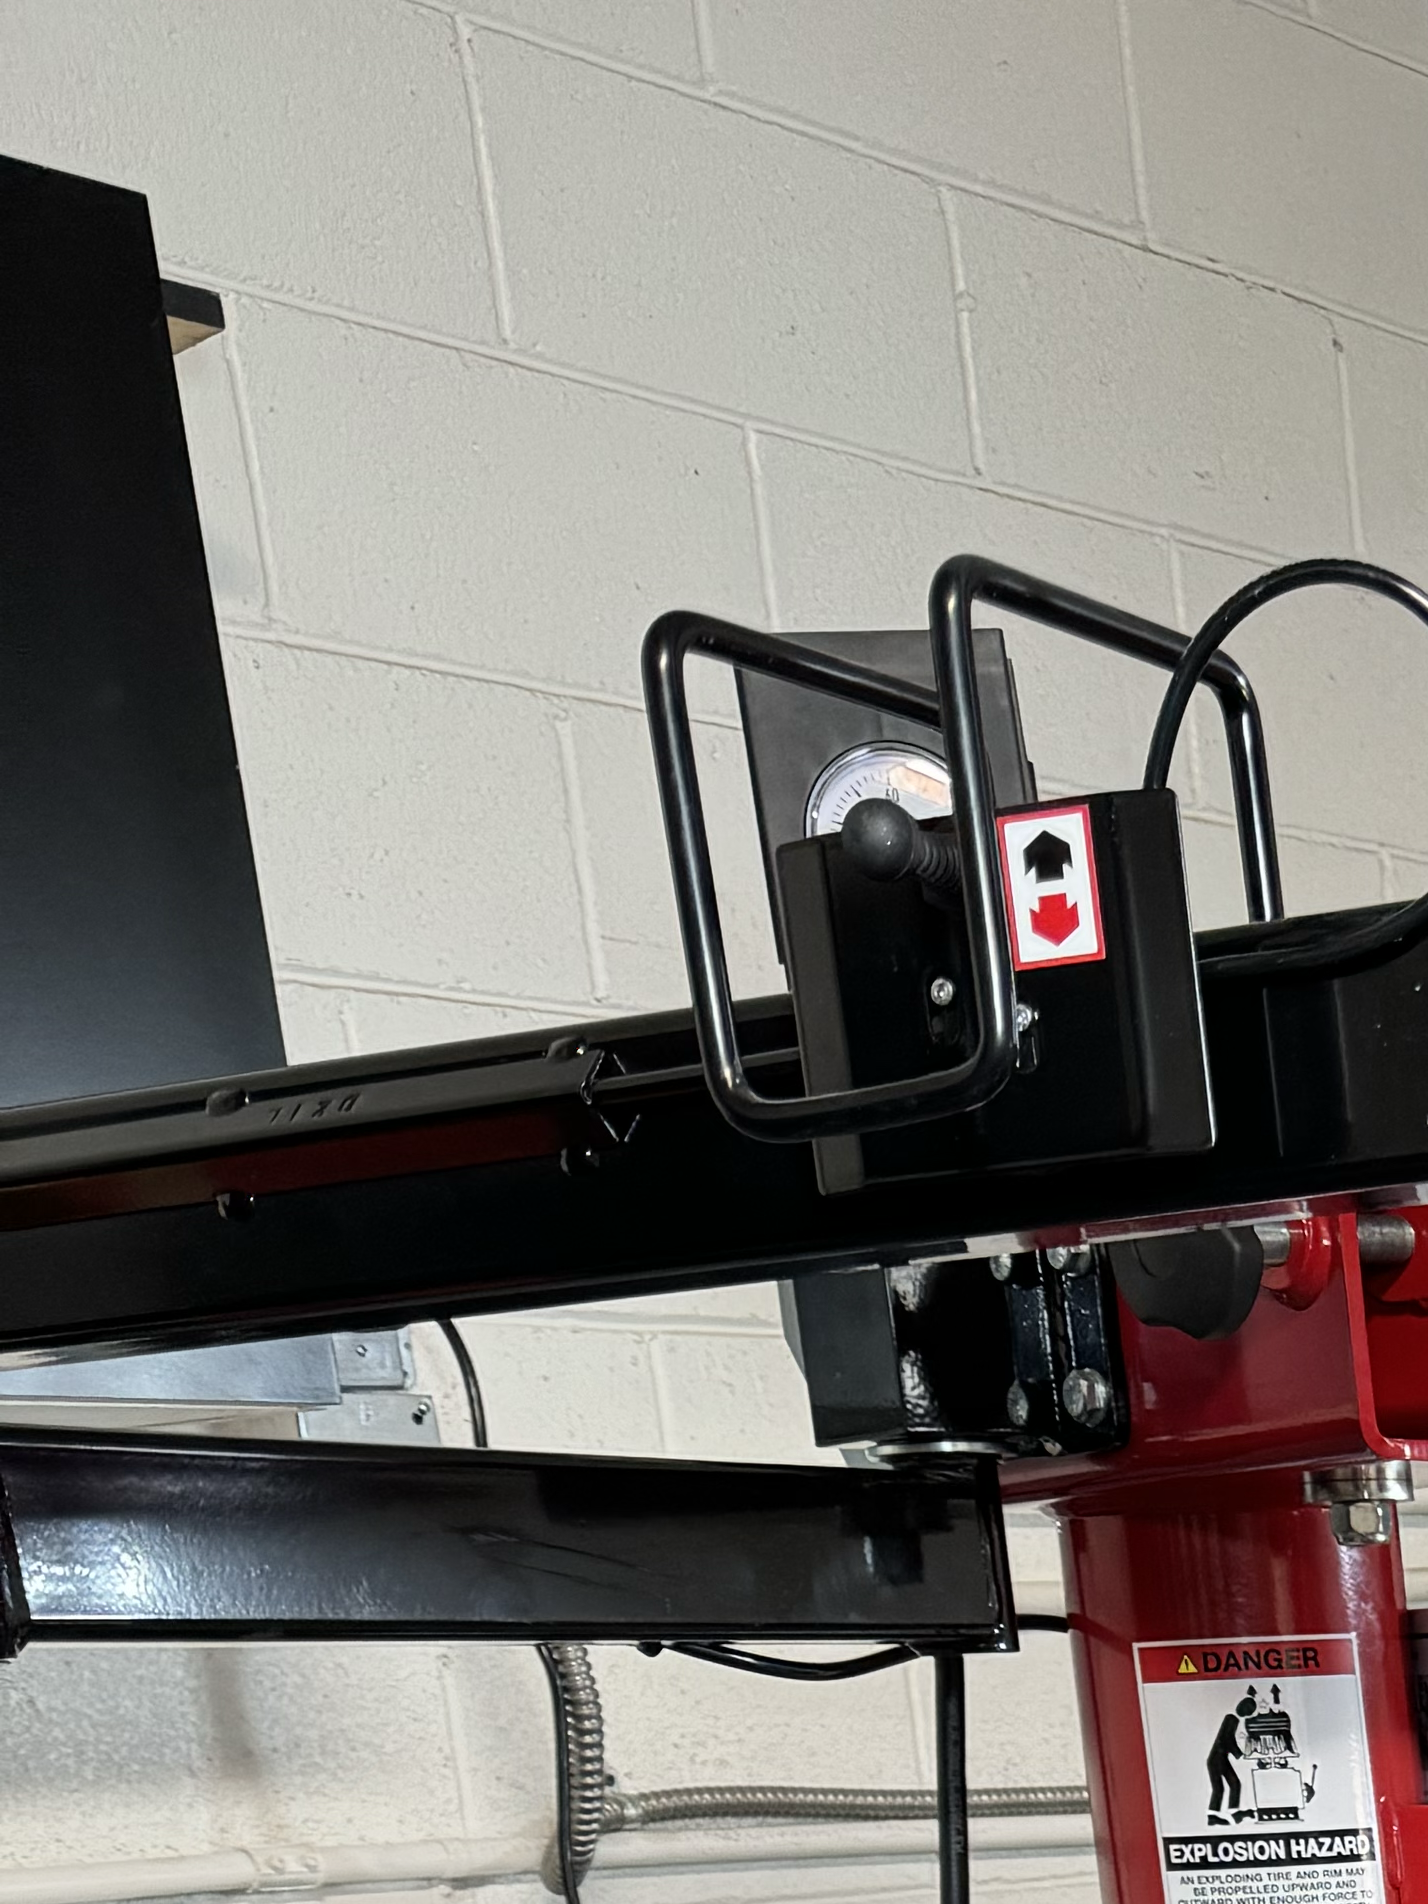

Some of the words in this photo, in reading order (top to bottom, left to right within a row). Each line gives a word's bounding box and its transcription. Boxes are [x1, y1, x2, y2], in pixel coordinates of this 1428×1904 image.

[1202, 1647, 1320, 1673] DANGER
[1169, 1840, 1285, 1863] EXPLOSION
[1290, 1834, 1370, 1859] HAZARD
[1180, 1876, 1195, 1885] AN
[1197, 1873, 1263, 1885] EXPLODING
[1267, 1871, 1292, 1882] TIRE
[1296, 1870, 1320, 1880] AND
[1322, 1869, 1343, 1878] RIM
[1345, 1867, 1367, 1877] MAY
[1193, 1887, 1208, 1897] BE
[1210, 1884, 1280, 1896] PROPELLED
[1282, 1881, 1332, 1892] UPWARD
[1335, 1880, 1357, 1889] AND
[1269, 1893, 1319, 1904] ENOUGH
[1322, 1891, 1358, 1902] FORCE
[1360, 1889, 1374, 1899] TO
